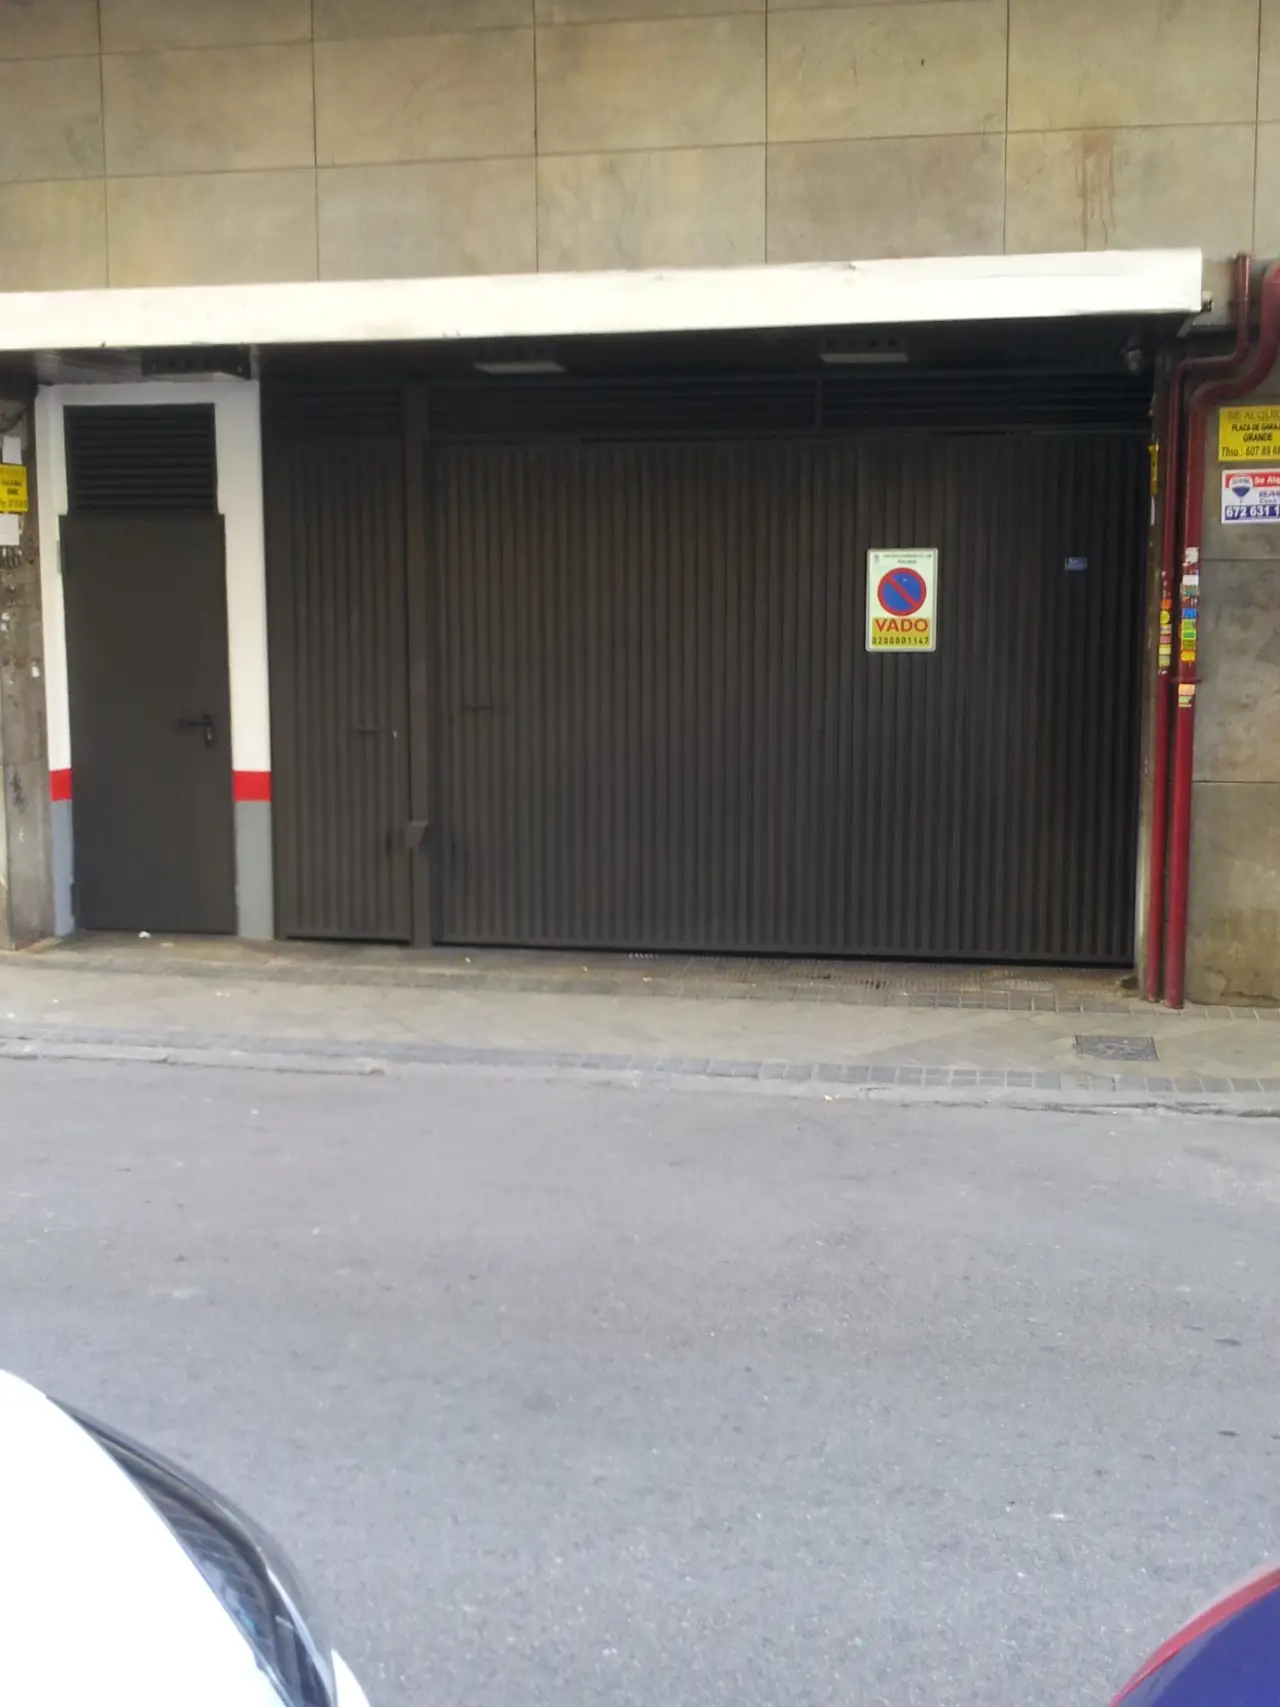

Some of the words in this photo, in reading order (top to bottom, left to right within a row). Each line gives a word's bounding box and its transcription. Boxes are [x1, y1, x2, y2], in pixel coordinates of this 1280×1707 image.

[1243, 433, 1273, 442] GRANDE
[1246, 446, 1259, 456] 607
[1226, 507, 1246, 517] 672
[1250, 505, 1270, 516] 631
[875, 618, 928, 632] VADO
